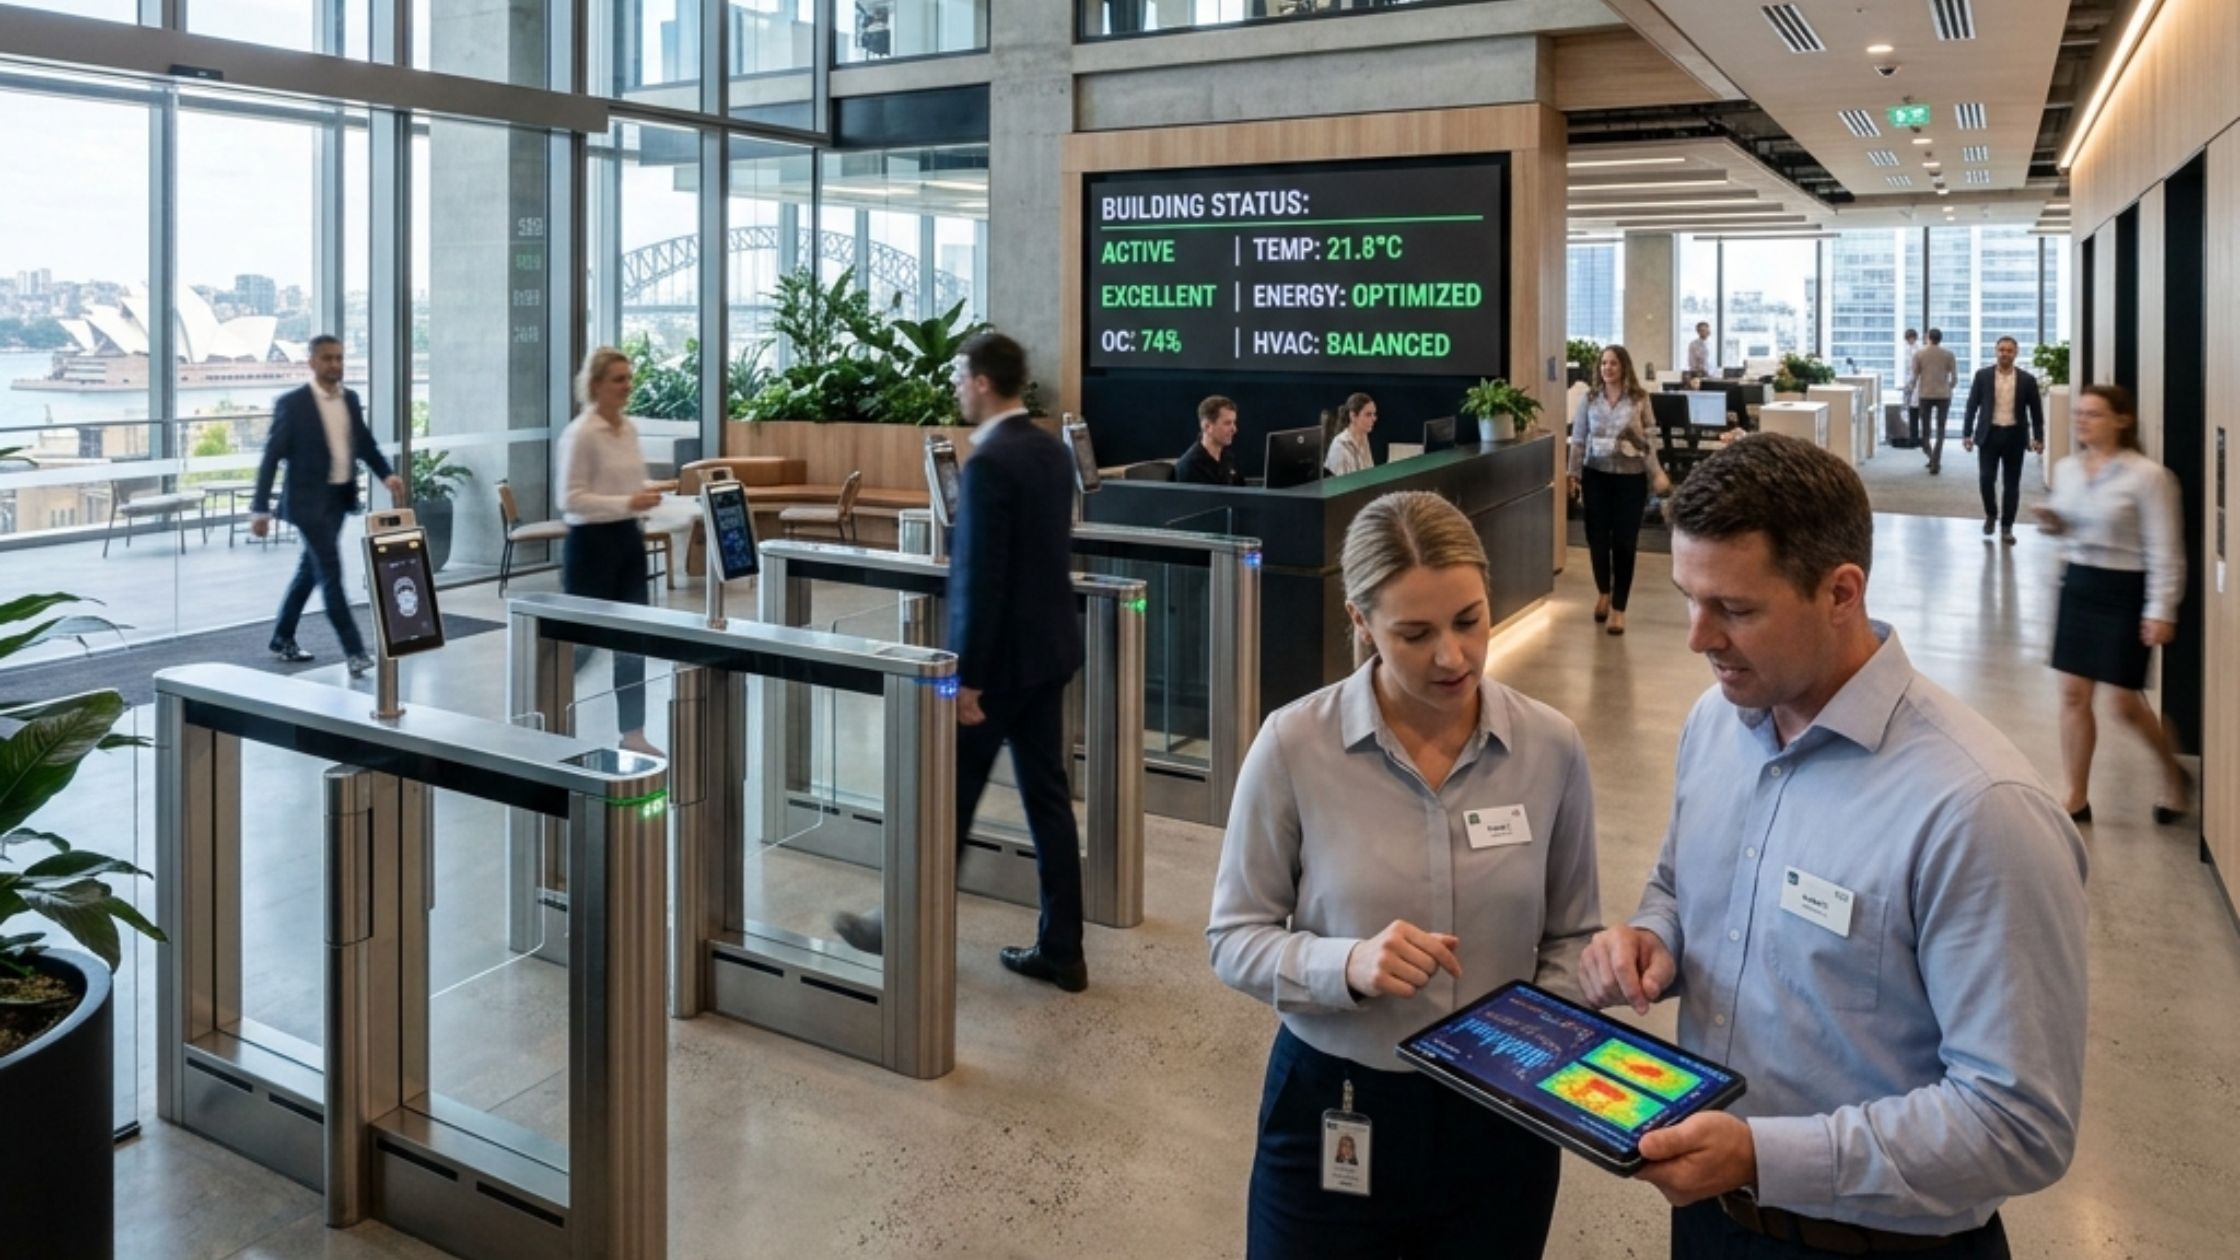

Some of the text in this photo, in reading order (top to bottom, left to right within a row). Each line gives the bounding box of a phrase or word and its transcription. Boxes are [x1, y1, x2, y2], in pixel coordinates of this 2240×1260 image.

[1101, 188, 1310, 220] BUILDING STATUS:
[1101, 239, 1176, 265] ACTIVE
[1253, 234, 1403, 262] TEMP: 21.8°C
[1101, 284, 1218, 308] EXCELLENT
[1253, 282, 1482, 309] ENERGY: OPTIMIZED
[1140, 329, 1183, 353] 74%
[1253, 330, 1320, 355] HVAC:
